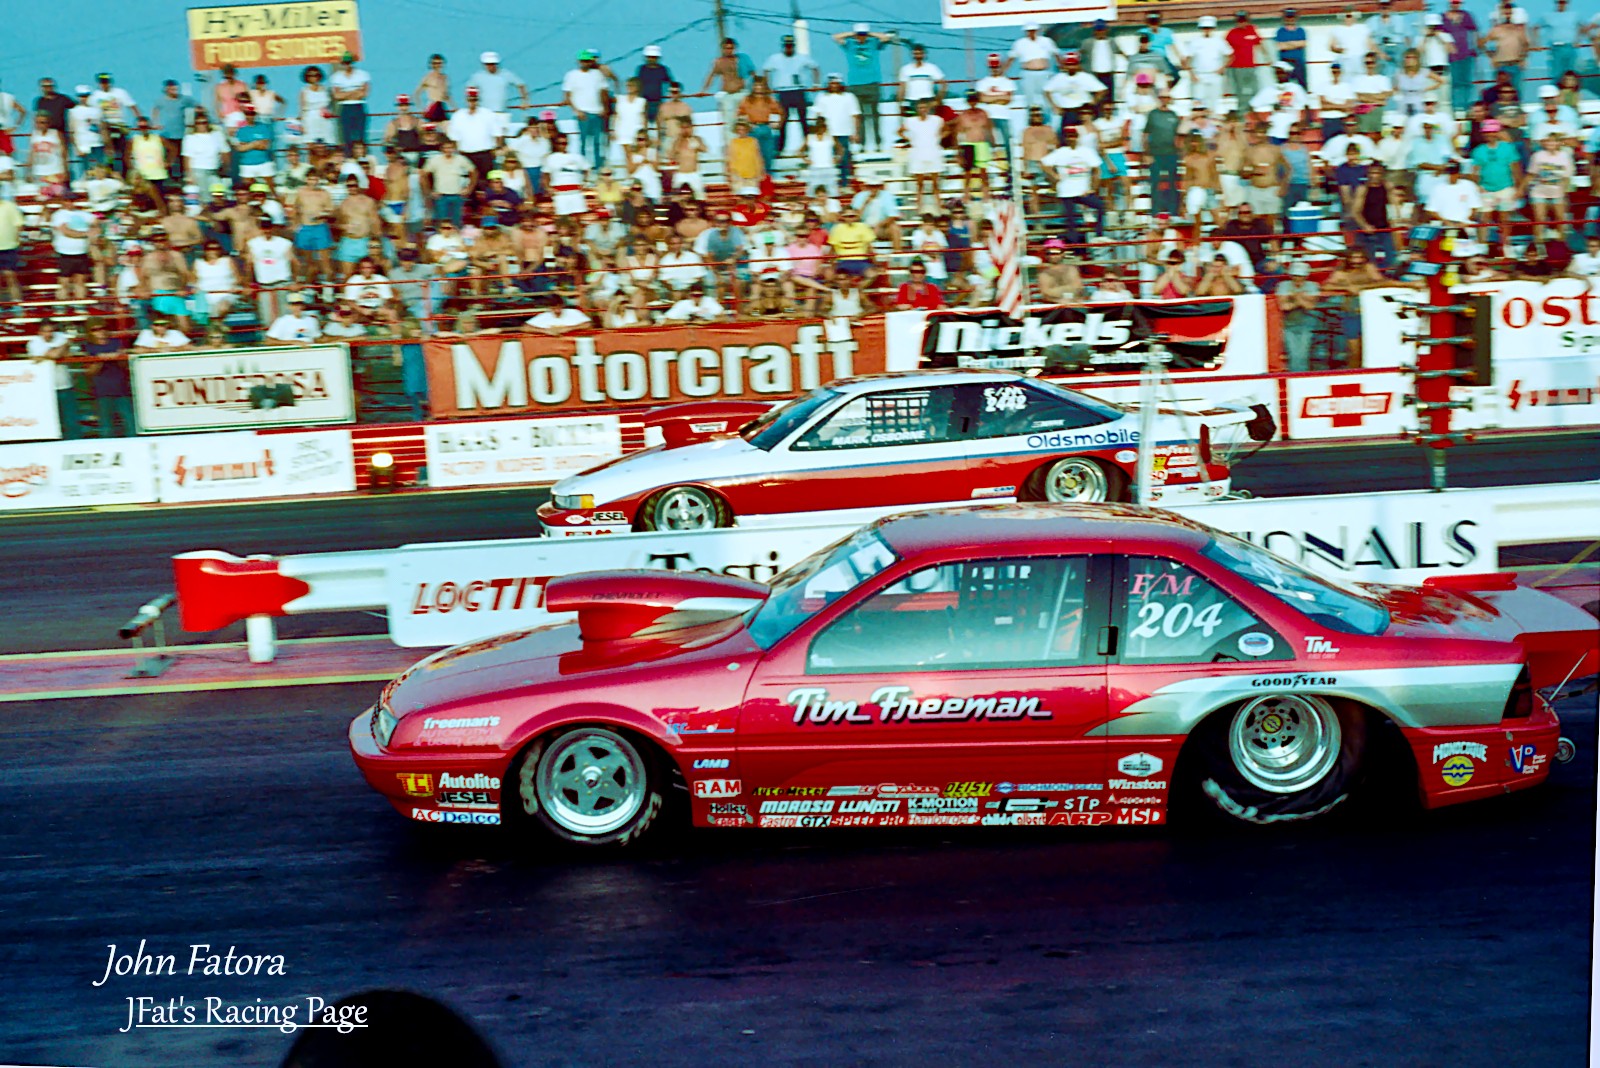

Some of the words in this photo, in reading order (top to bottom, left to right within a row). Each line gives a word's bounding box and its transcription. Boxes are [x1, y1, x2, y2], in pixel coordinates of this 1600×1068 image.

[450, 323, 859, 411] Motorcraft
[1027, 429, 1141, 449] Oldsmobile
[411, 575, 550, 615] LOCTIT
[1129, 601, 1224, 639] 204
[1304, 636, 1340, 653] TM
[787, 687, 873, 725] Tim
[870, 685, 1053, 723] Freeman
[423, 716, 501, 730] freeman's
[692, 759, 731, 769] LAMB
[438, 772, 501, 789] Autolite
[694, 781, 741, 795] RAM
[1108, 779, 1167, 790] Winston
[435, 792, 499, 805] JESEL
[908, 798, 979, 809] K-MOTION
[1063, 795, 1100, 813] STP
[759, 800, 835, 814] MOROSO
[838, 800, 901, 814] LUNATI
[800, 815, 832, 828] GTX
[1048, 812, 1113, 827] ARP
[1116, 807, 1161, 825] MSD
